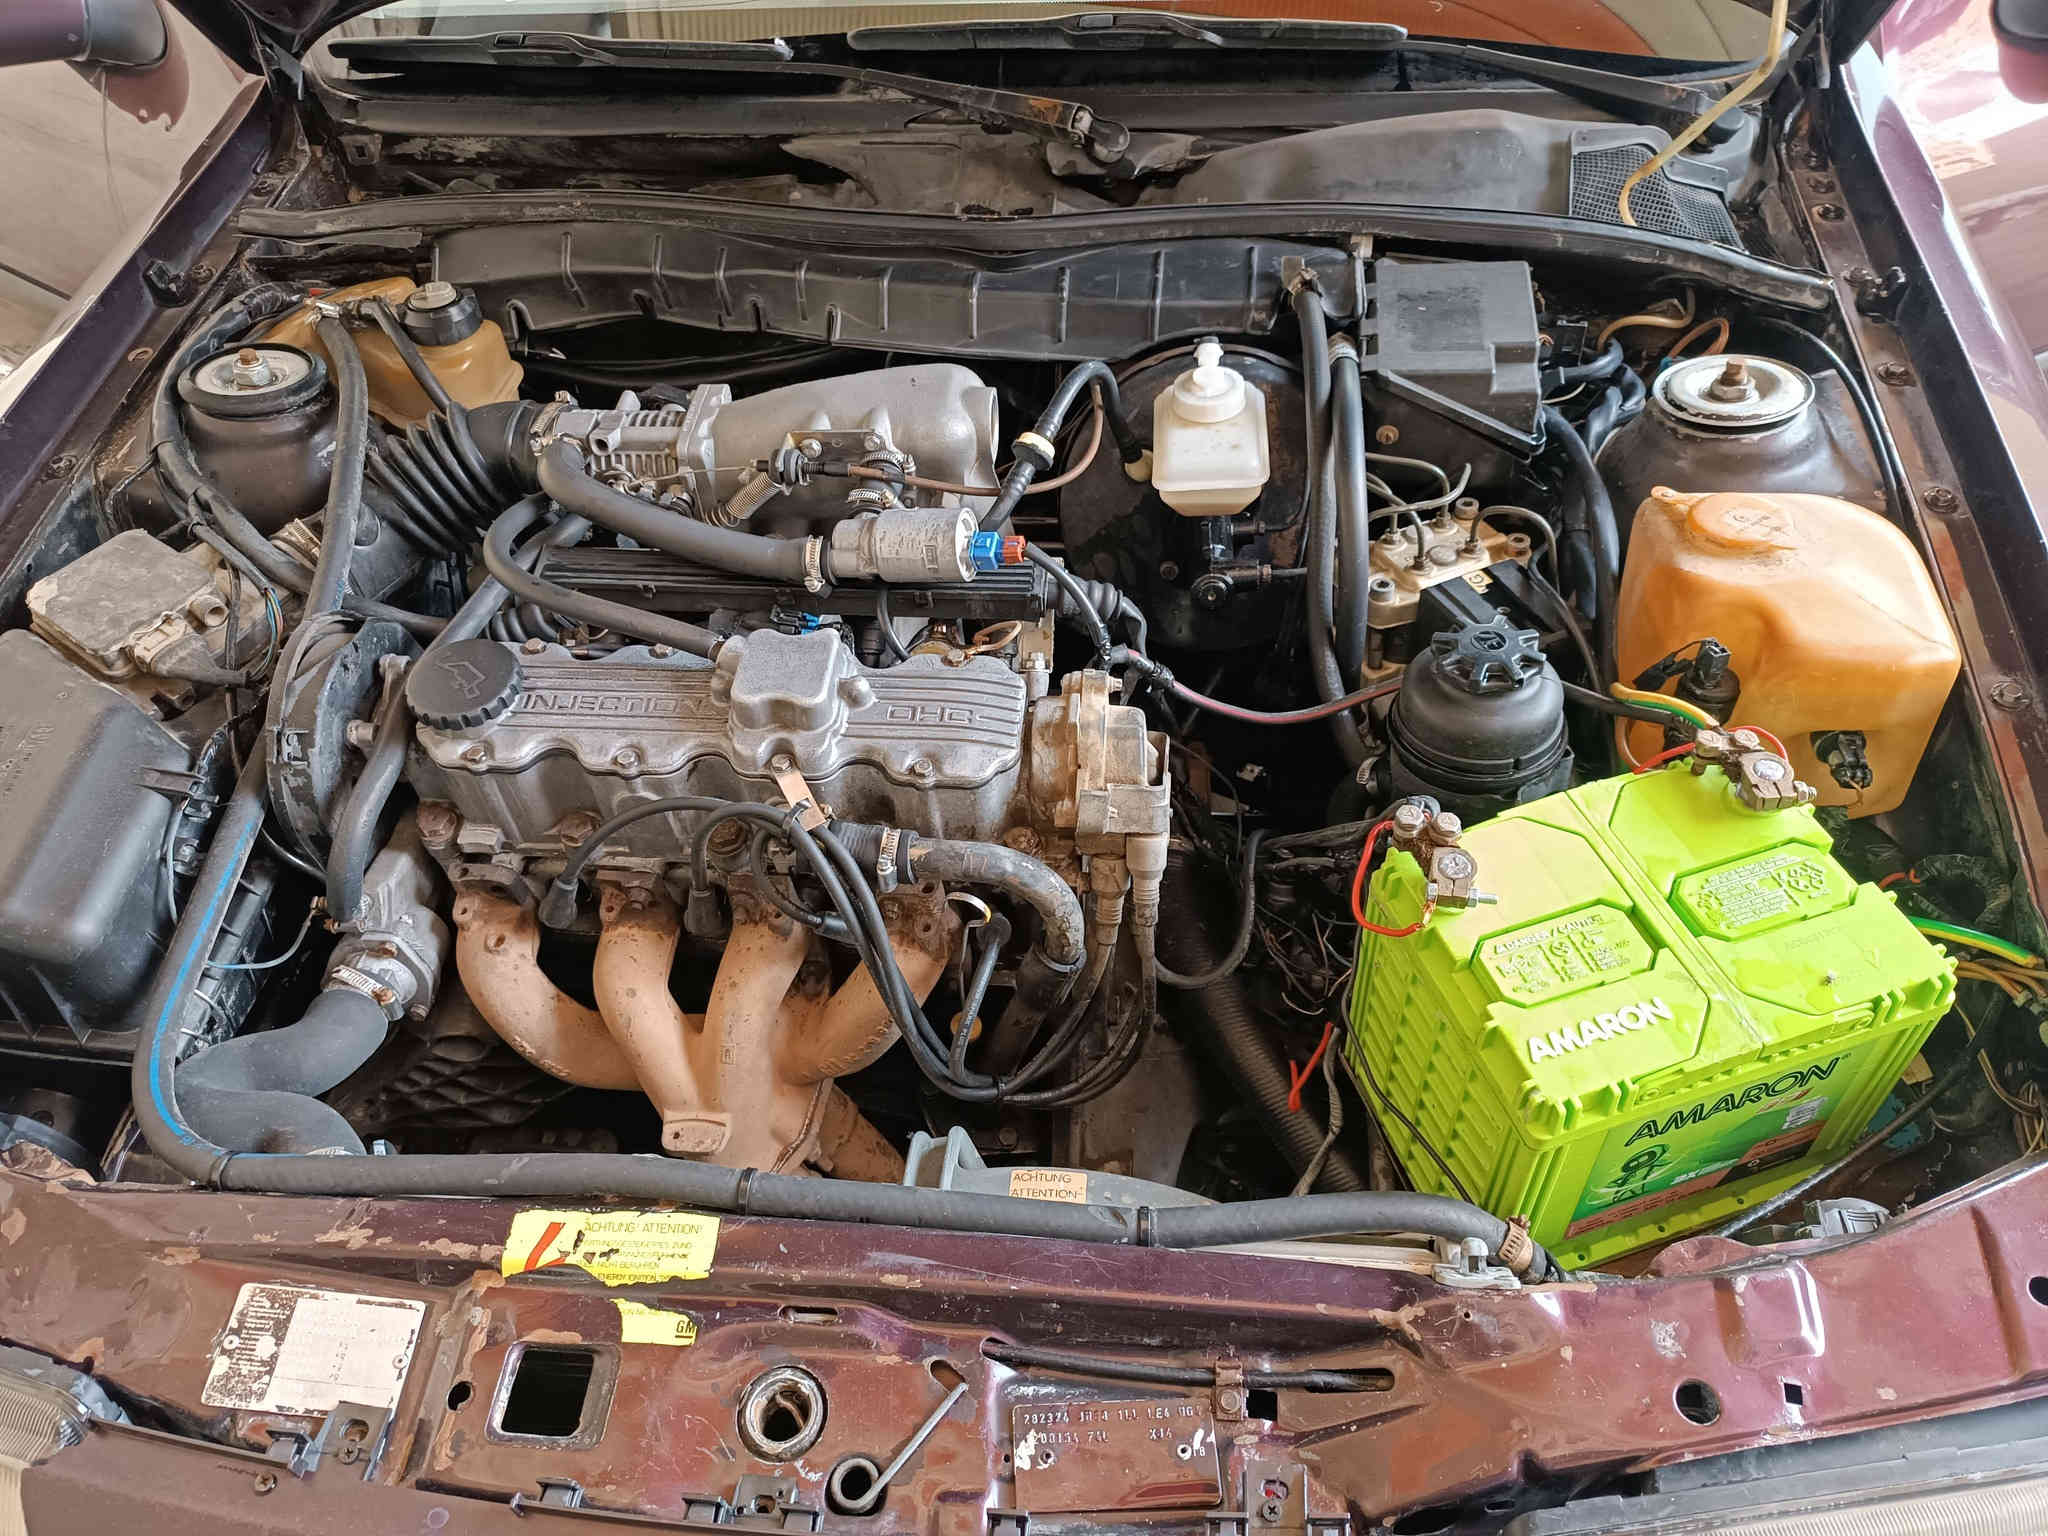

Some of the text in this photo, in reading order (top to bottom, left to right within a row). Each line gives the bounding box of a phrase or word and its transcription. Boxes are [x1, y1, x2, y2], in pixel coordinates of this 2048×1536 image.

[522, 693, 706, 715] INJECTION
[1528, 997, 1673, 1064] AMARON
[1623, 1057, 1841, 1147] AMARON
[1013, 1172, 1072, 1184] ACHTUNG
[1011, 1187, 1077, 1200] ATTENTION
